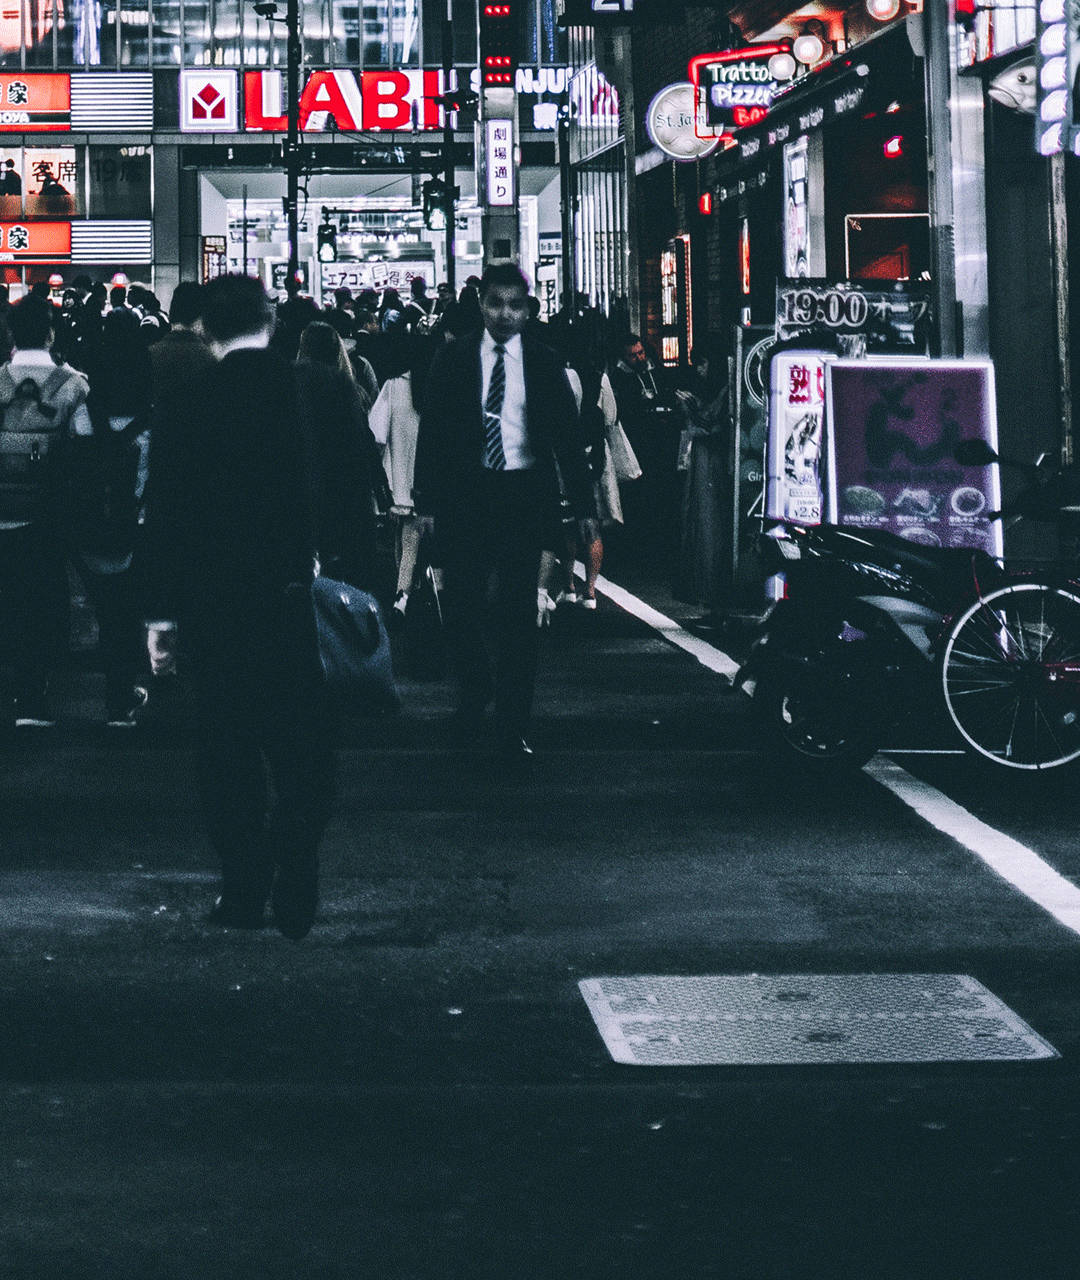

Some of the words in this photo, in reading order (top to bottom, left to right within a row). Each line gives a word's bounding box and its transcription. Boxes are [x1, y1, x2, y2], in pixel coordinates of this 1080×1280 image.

[708, 63, 773, 83] Tratto
[244, 69, 458, 132] LABI
[493, 127, 508, 198] 劇場通り
[781, 290, 869, 328] 19:00
